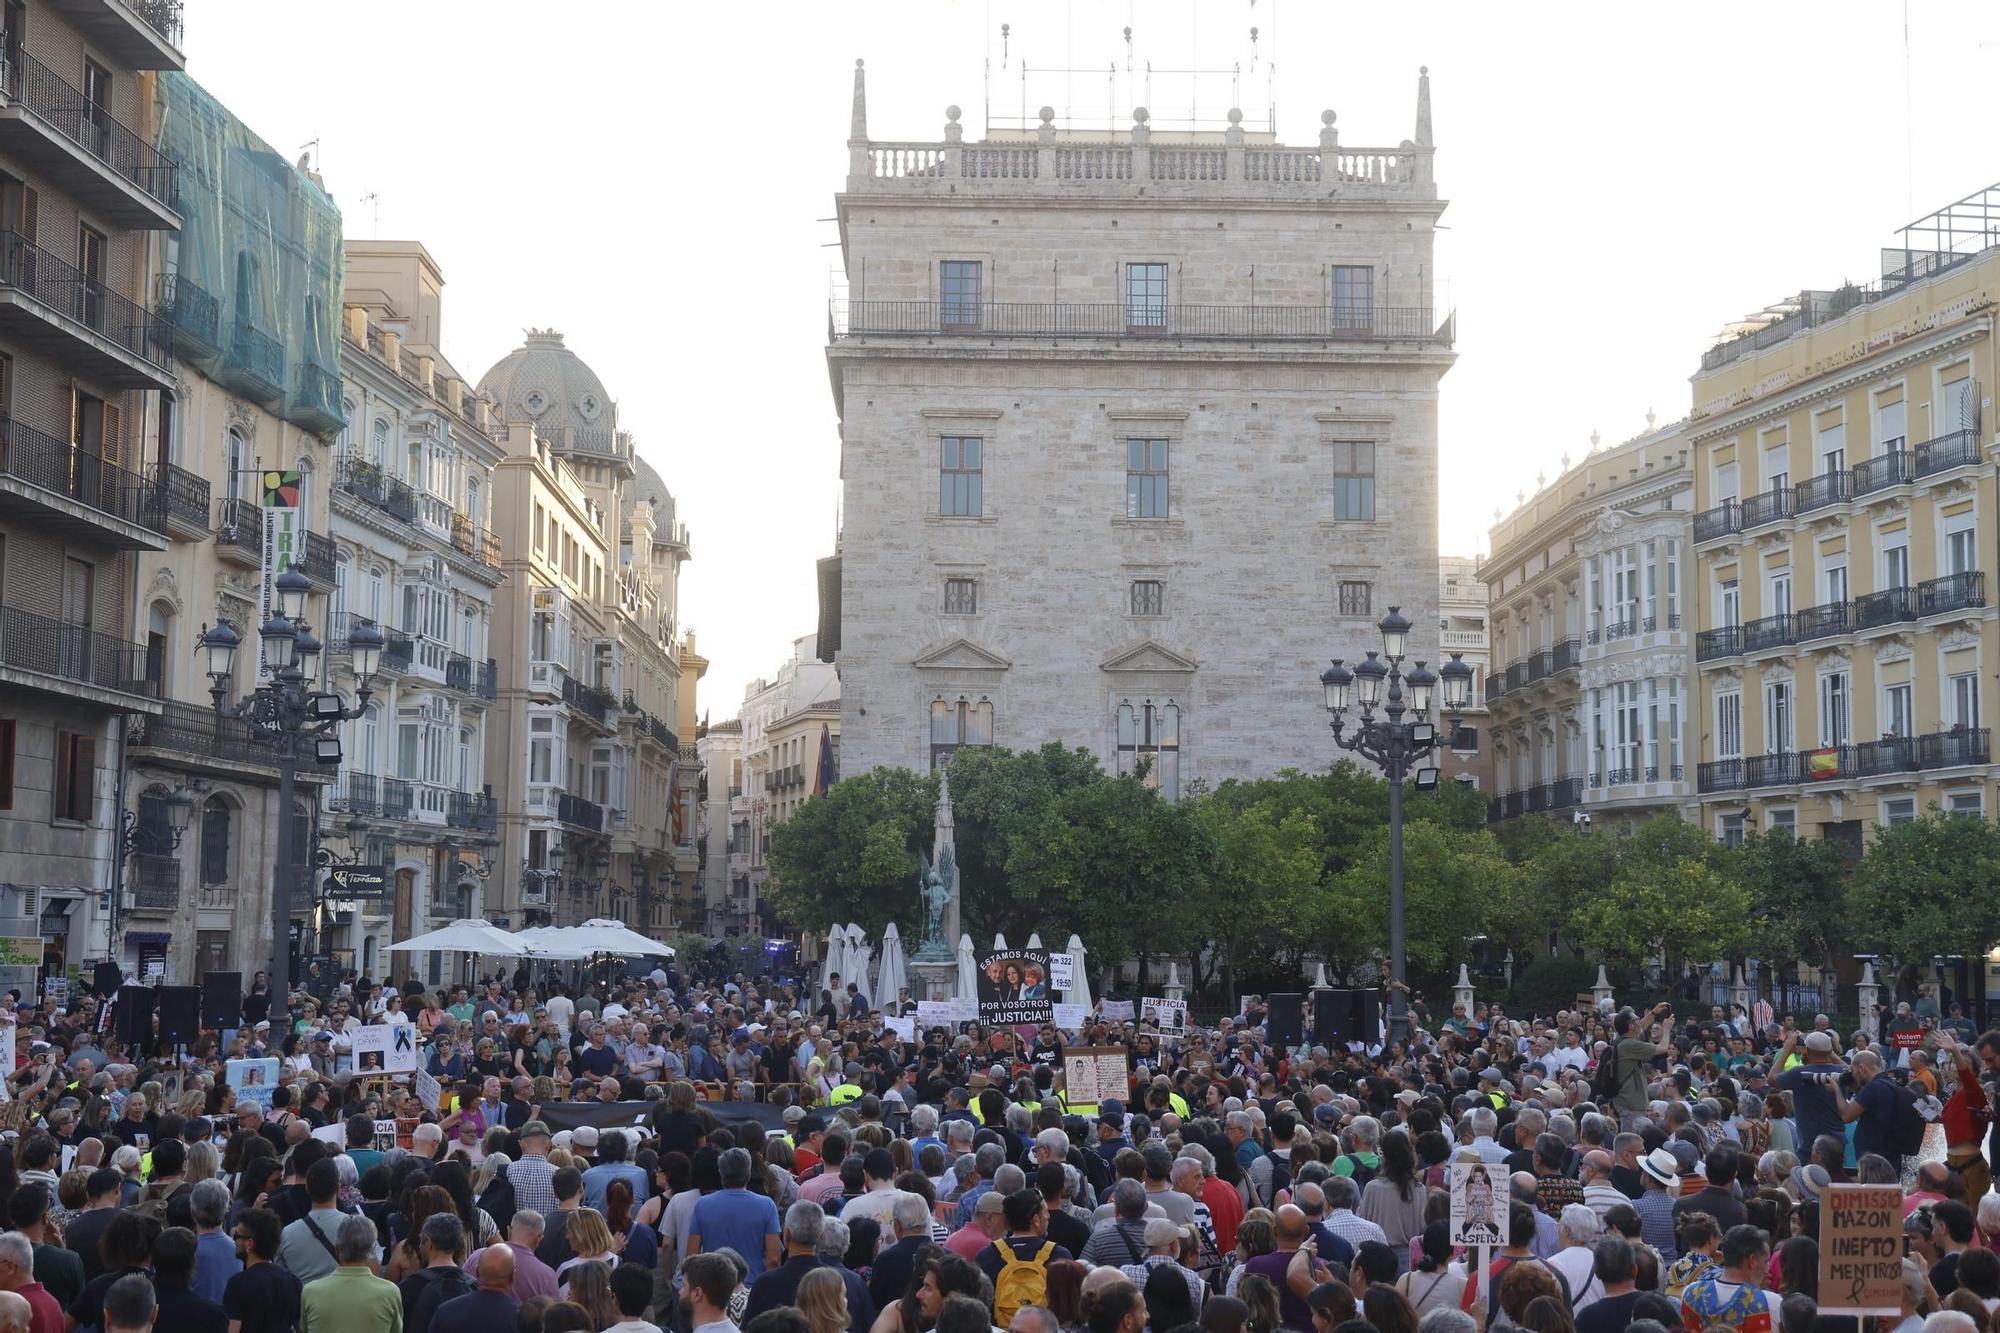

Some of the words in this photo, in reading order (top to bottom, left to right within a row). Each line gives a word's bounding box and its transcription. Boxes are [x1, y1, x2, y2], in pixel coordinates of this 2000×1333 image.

[265, 511, 274, 544] AMBIENTE
[264, 544, 273, 567] MEDIO
[349, 873, 383, 883] Terrazza
[980, 950, 1021, 970] ESTAMOS
[1060, 957, 1072, 965] 322
[1056, 978, 1072, 988] 19:50
[981, 1002, 1000, 1010] POR
[1001, 999, 1049, 1009] VOSOTROS
[1143, 998, 1186, 1009] JUSTICIA
[1832, 1210, 1891, 1228] MAZON
[1455, 1233, 1498, 1244] RESPETO
[1832, 1237, 1896, 1257] INEPTO
